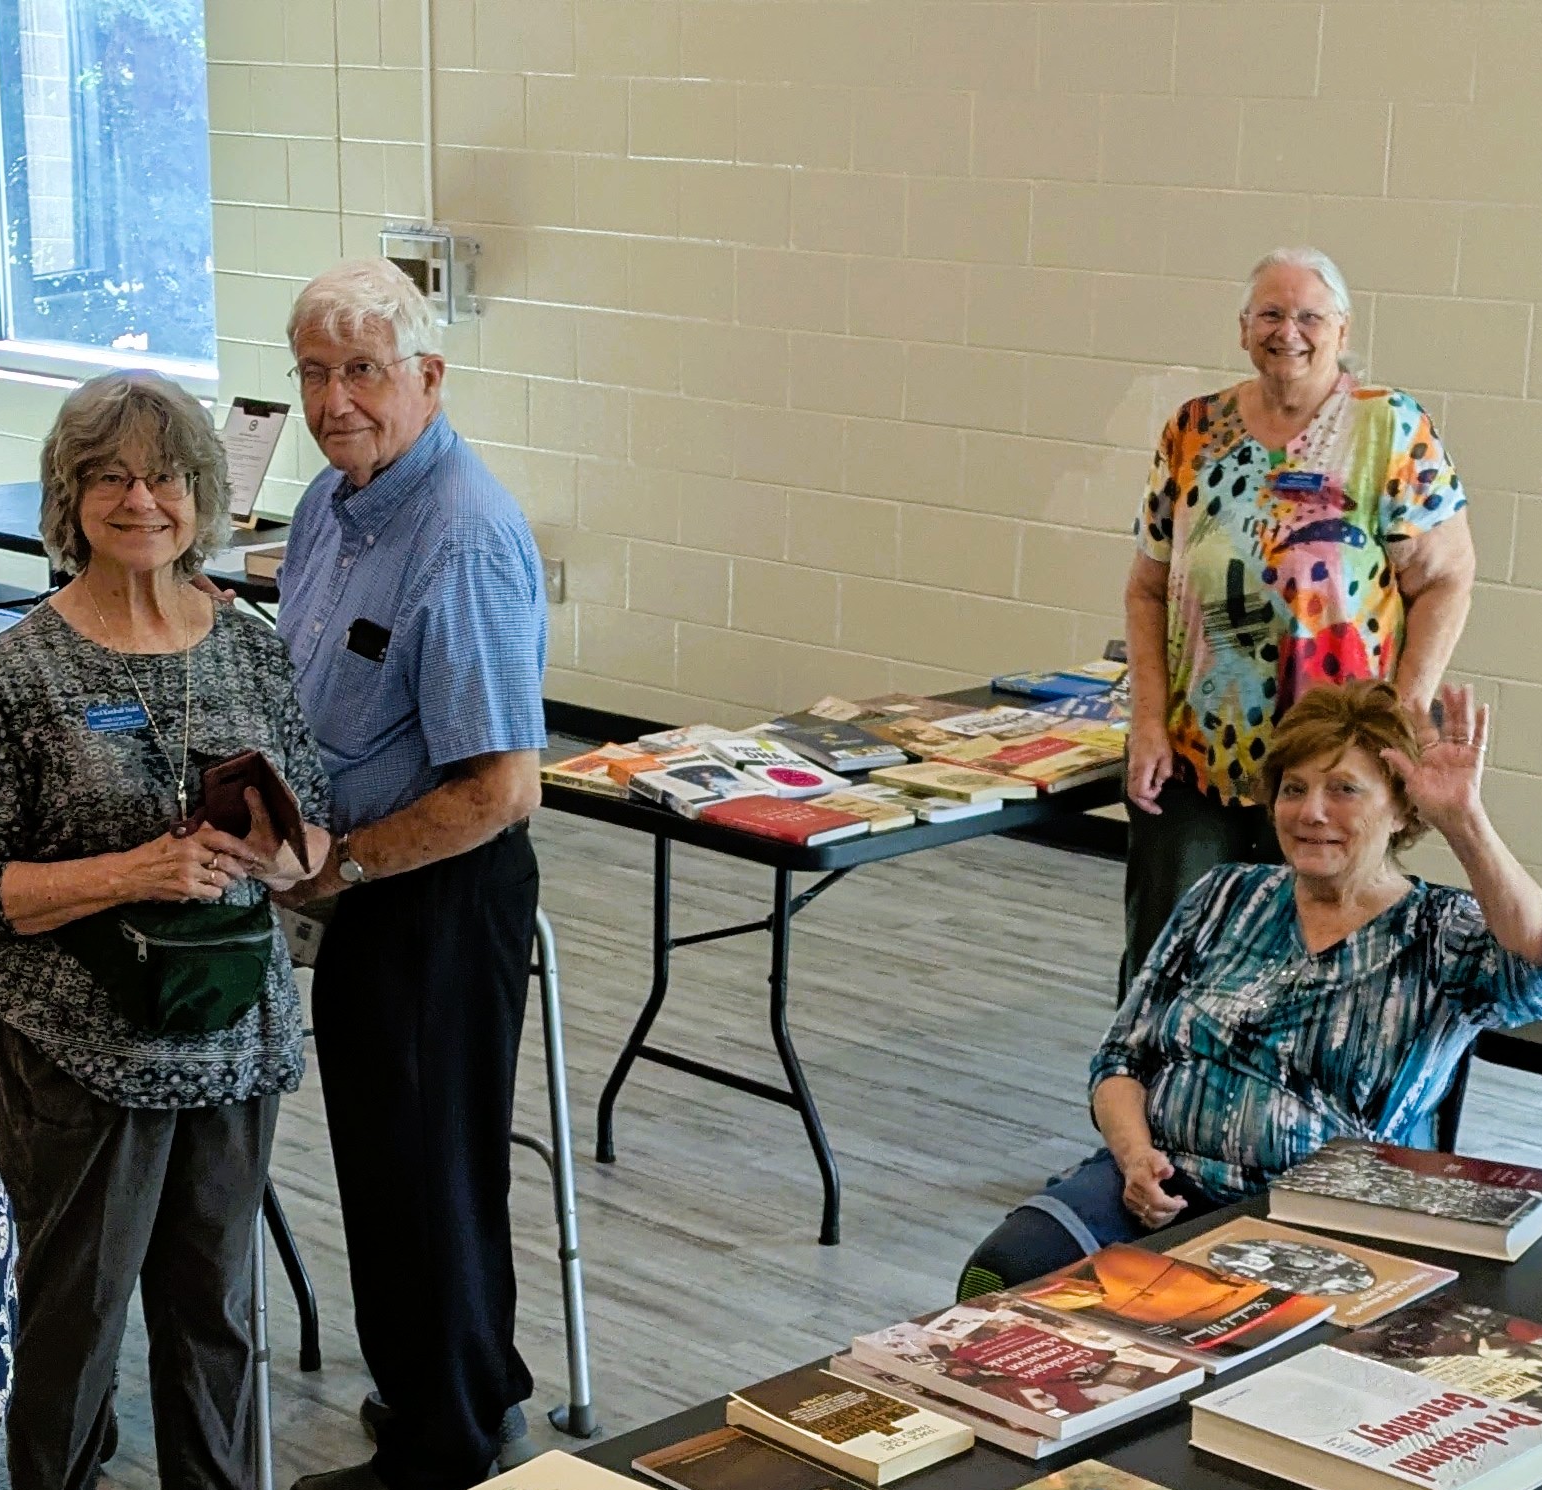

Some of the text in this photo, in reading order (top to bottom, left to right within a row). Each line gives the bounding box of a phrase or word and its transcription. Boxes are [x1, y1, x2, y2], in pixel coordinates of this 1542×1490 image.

[743, 751, 786, 760] DNA
[982, 1340, 1057, 1369] Sourcebook
[997, 1342, 1077, 1371] Companion
[1013, 1348, 1096, 1380] Genealogist's
[1342, 1386, 1494, 1453] Genealogy
